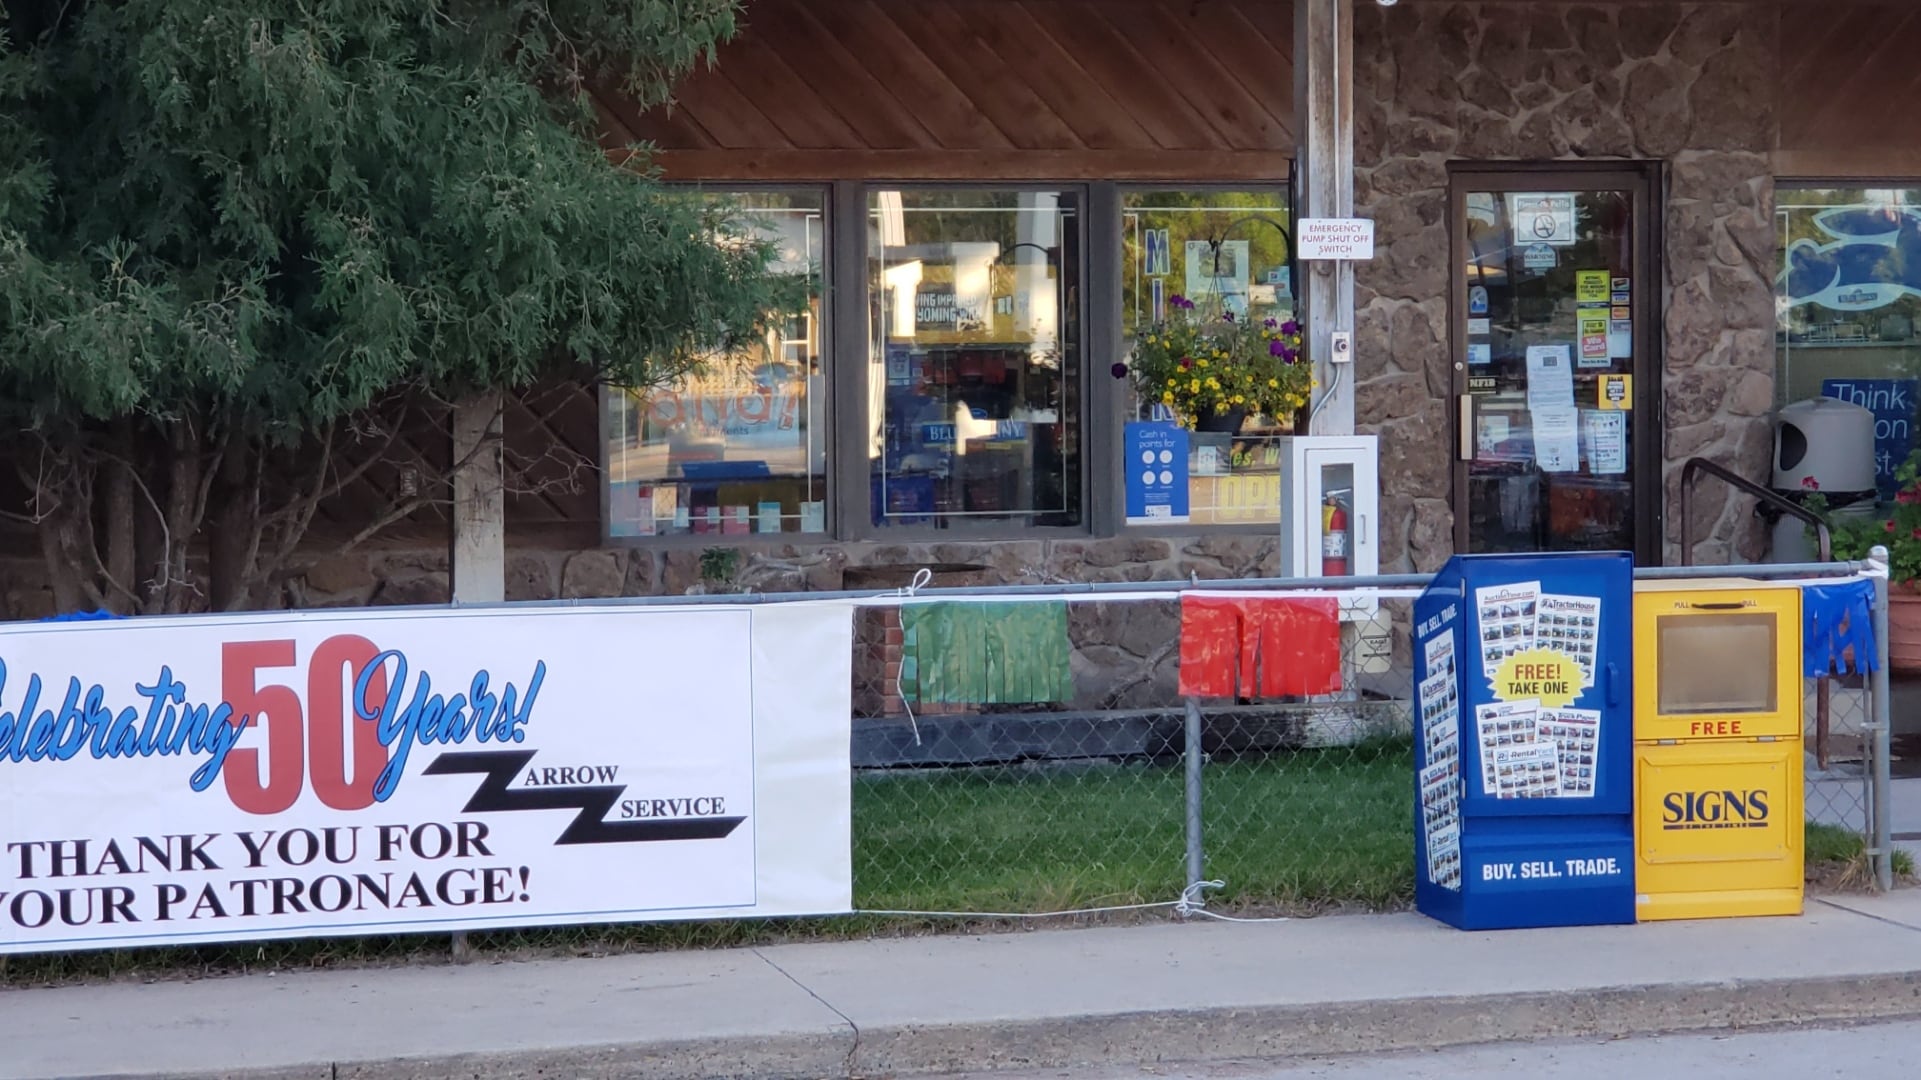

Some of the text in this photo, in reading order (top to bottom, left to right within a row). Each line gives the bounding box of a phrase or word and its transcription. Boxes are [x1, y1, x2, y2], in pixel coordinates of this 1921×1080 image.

[1309, 224, 1362, 233] EMERGENCY
[1302, 234, 1369, 243] PUMP SHUT OFF
[1319, 245, 1352, 253] SWITCH
[917, 307, 957, 323] YOMING
[1832, 383, 1907, 410] Think
[1139, 429, 1168, 439] Cash in
[1139, 439, 1176, 449] points for
[1217, 474, 1280, 519] OPE
[1552, 599, 1596, 610] TractorHouse
[1514, 663, 1562, 680] FREE!
[1508, 681, 1569, 696] TAKE ONE
[0, 634, 546, 815] elebrating 50 Years!
[1690, 721, 1742, 736] FREE
[524, 764, 619, 787] ARROW
[620, 796, 726, 819] SERVICE
[1662, 789, 1769, 824] SIGNS
[7, 820, 495, 879] THANK YOU FOR
[1482, 858, 1622, 881] BUY. SELL. TRADE.
[0, 865, 531, 929] OUR PATRONAGE!
